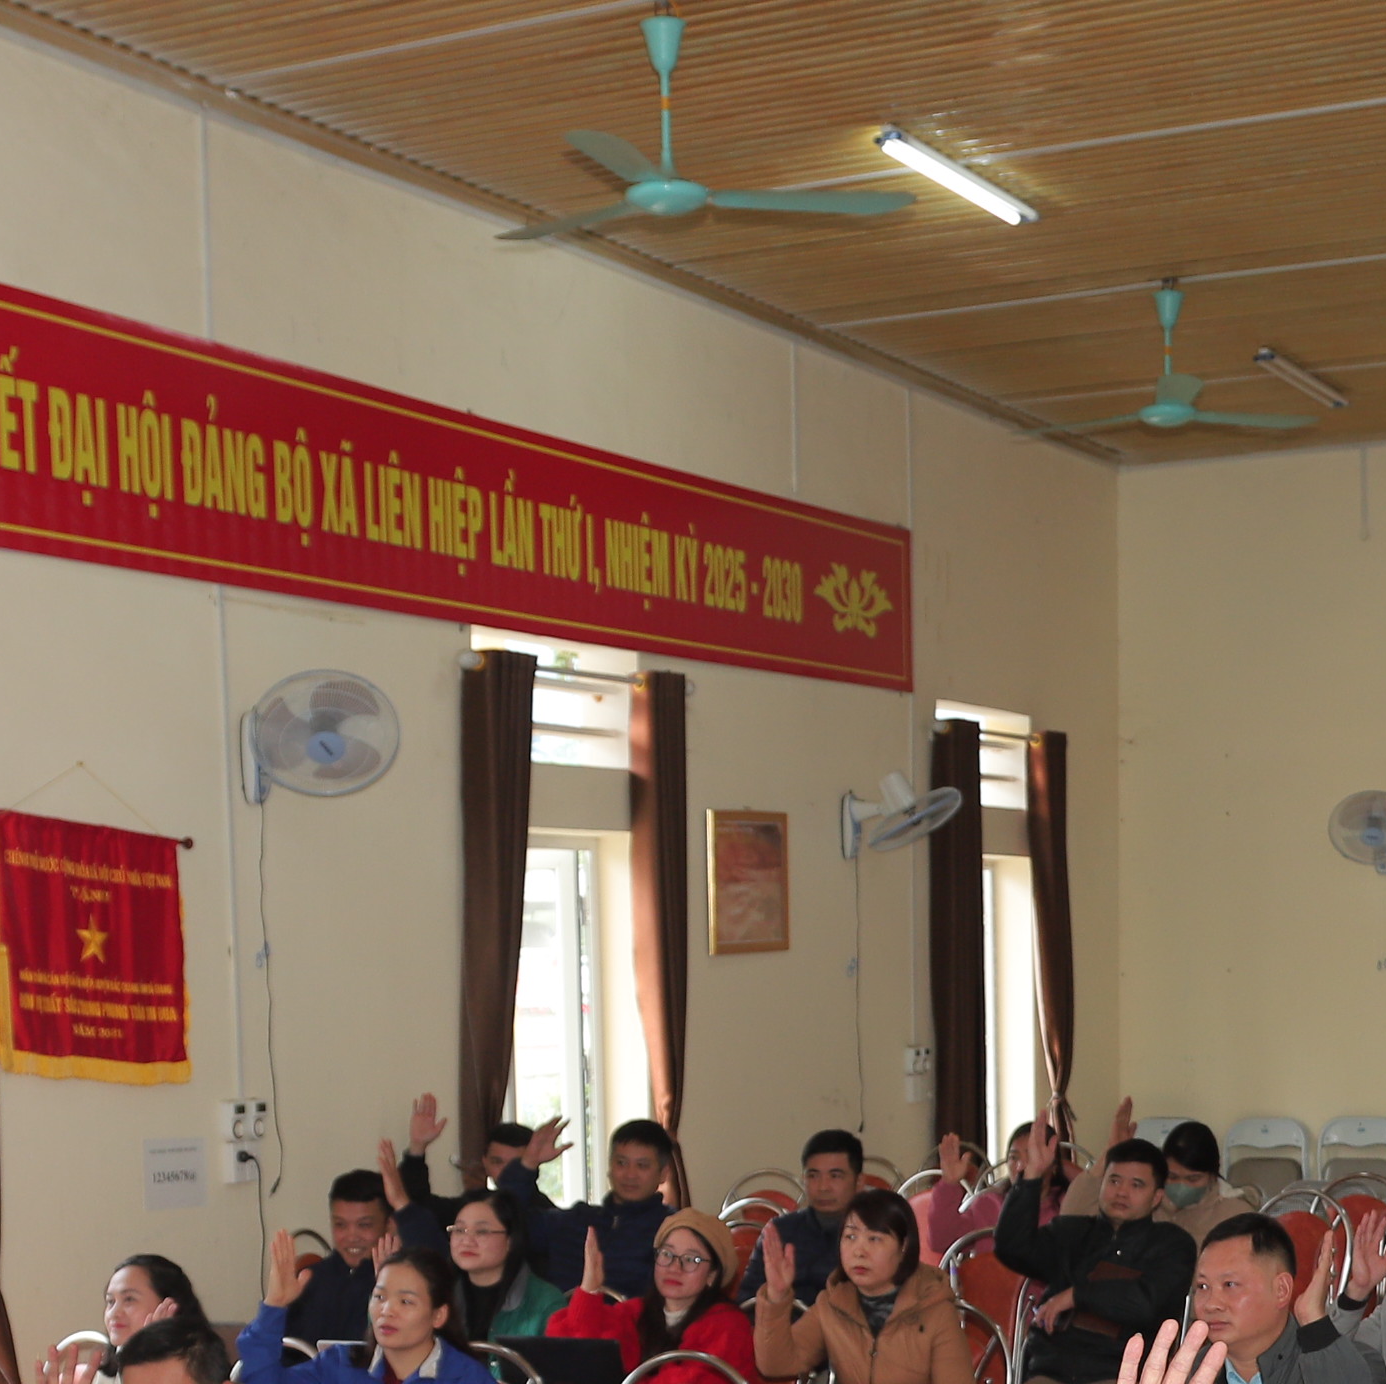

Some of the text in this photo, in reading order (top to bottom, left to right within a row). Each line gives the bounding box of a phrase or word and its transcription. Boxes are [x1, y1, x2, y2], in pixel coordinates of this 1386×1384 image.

[47, 386, 110, 506] ĐẠI
[116, 389, 173, 519] HỘI
[180, 394, 267, 519] ĐẢNG
[273, 427, 312, 547] BỘ
[319, 440, 357, 537] XÃ
[363, 450, 423, 550] LIÊN
[427, 465, 484, 577] HIỆP
[488, 469, 536, 574] LẦN
[538, 493, 583, 582] THỨ
[584, 512, 601, 594] I,
[604, 512, 669, 611] NHIỆM
[673, 521, 701, 603] KỲ
[703, 542, 747, 614] 2025
[761, 554, 804, 623] 2030
